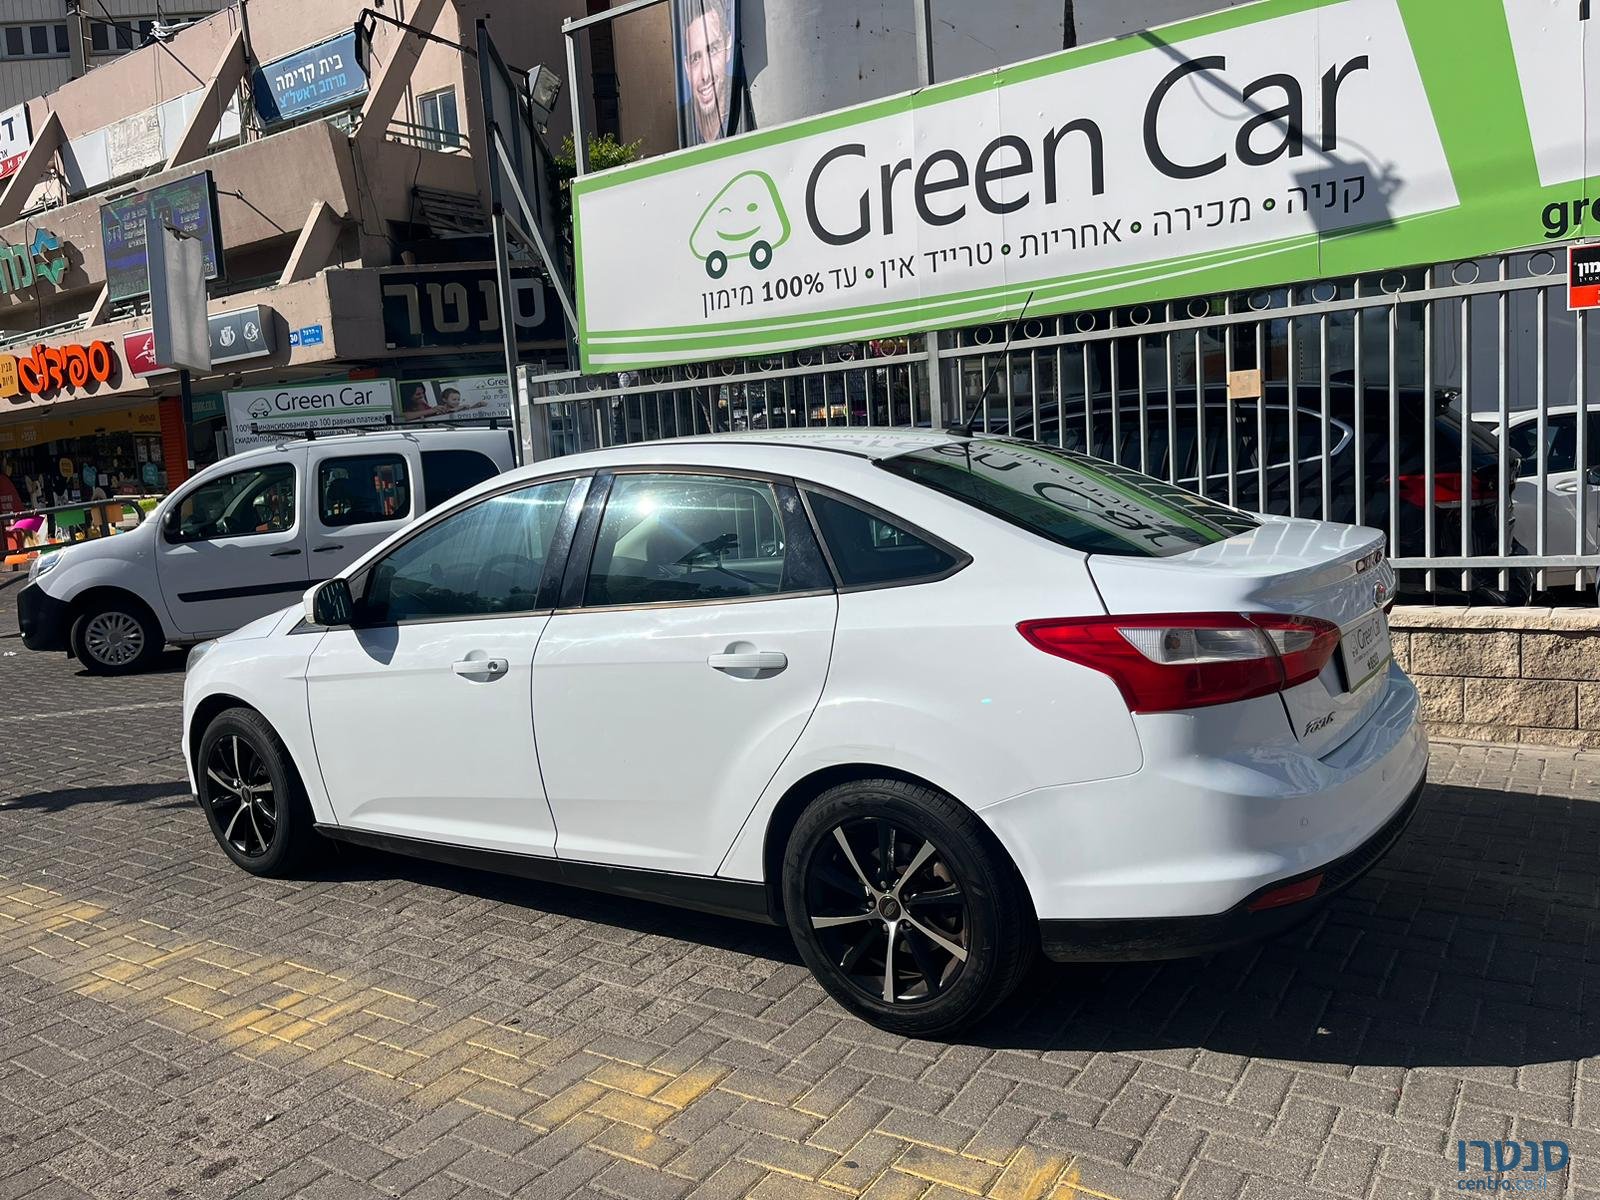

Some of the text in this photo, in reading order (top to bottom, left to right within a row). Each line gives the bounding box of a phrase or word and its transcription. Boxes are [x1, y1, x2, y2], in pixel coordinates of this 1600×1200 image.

[276, 54, 343, 91] בית קדימה
[318, 73, 347, 94] מרחב
[805, 55, 1369, 246] Green Car
[702, 175, 1366, 318] קניה מכירה אחריות טרייד אין עד 100% מימון
[384, 278, 546, 335] סנטר
[487, 379, 509, 387] Gree
[275, 387, 373, 411] Green Car
[258, 420, 309, 431] инансирование
[319, 418, 331, 426] 100
